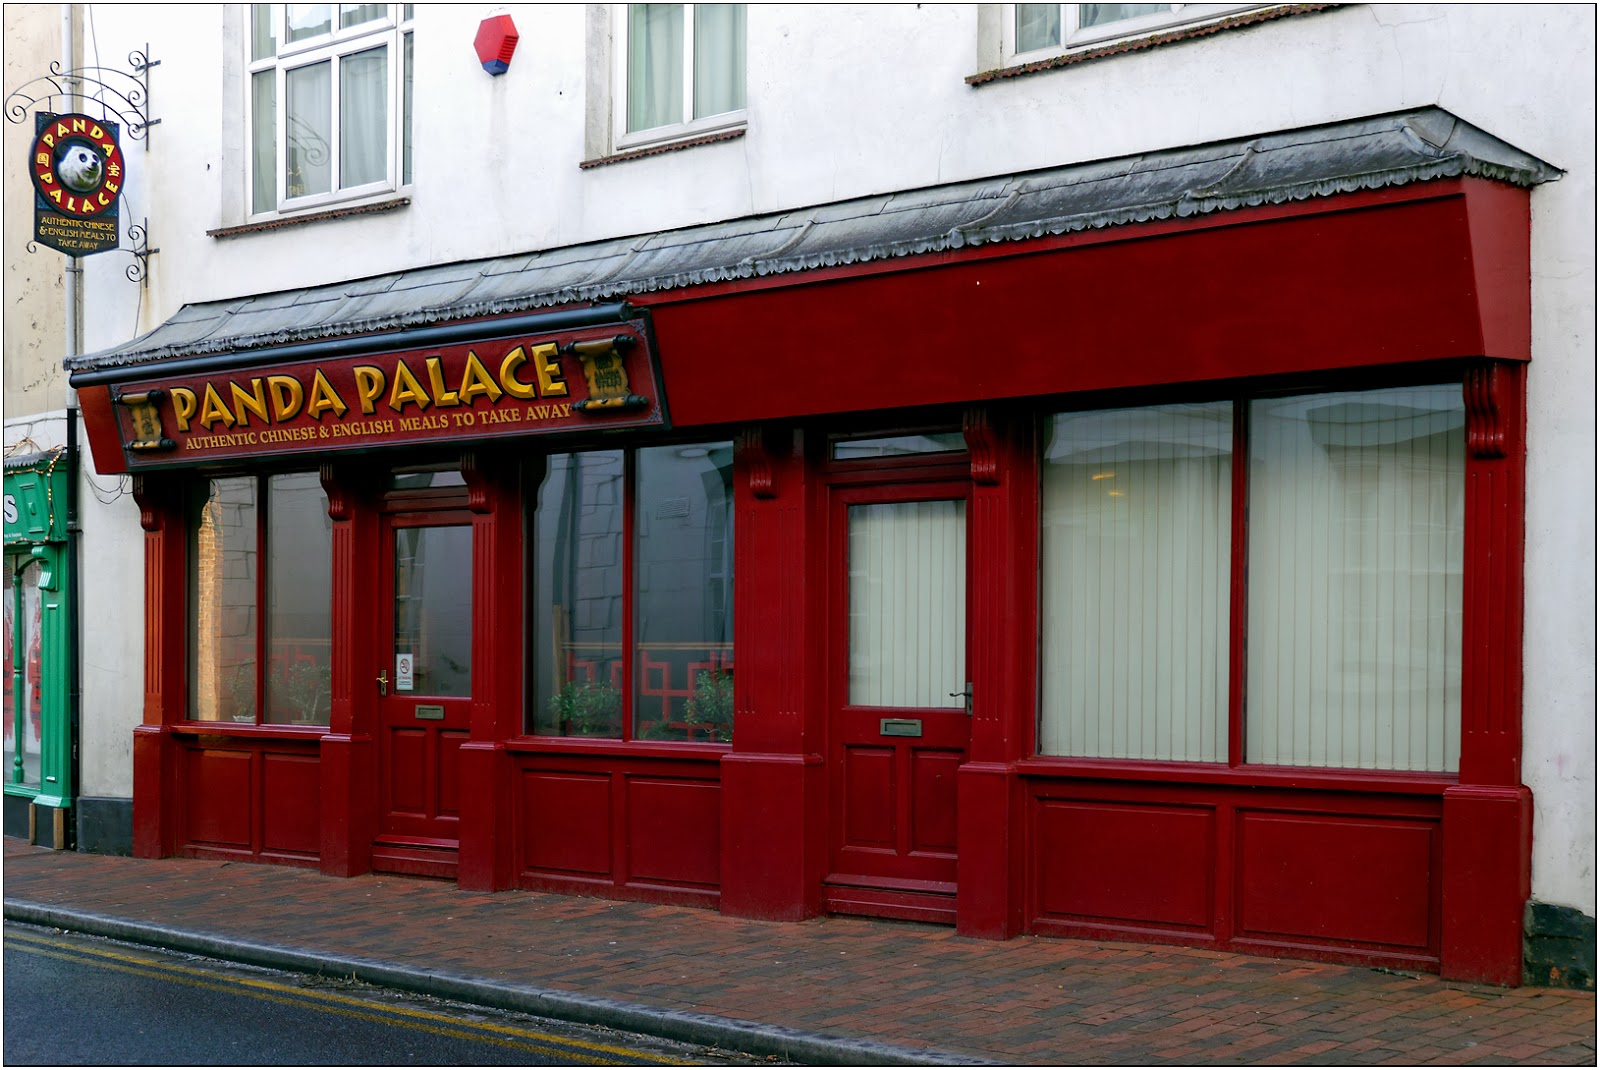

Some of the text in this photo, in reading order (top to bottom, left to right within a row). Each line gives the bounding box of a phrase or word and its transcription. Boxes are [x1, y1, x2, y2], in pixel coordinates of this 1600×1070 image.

[43, 118, 115, 157] PANDA
[40, 172, 118, 213] PALACE
[39, 226, 116, 242] & ENGLISH MEALS TO
[41, 216, 115, 231] AUTHENTIC CHINESE
[58, 238, 98, 250] TAKE AWAY
[169, 367, 348, 432] PANDA
[353, 342, 568, 414] PALACE
[186, 402, 571, 450] AUTHENTIC CHINESE & ENGLISH MEALS TO TAKE AWAY
